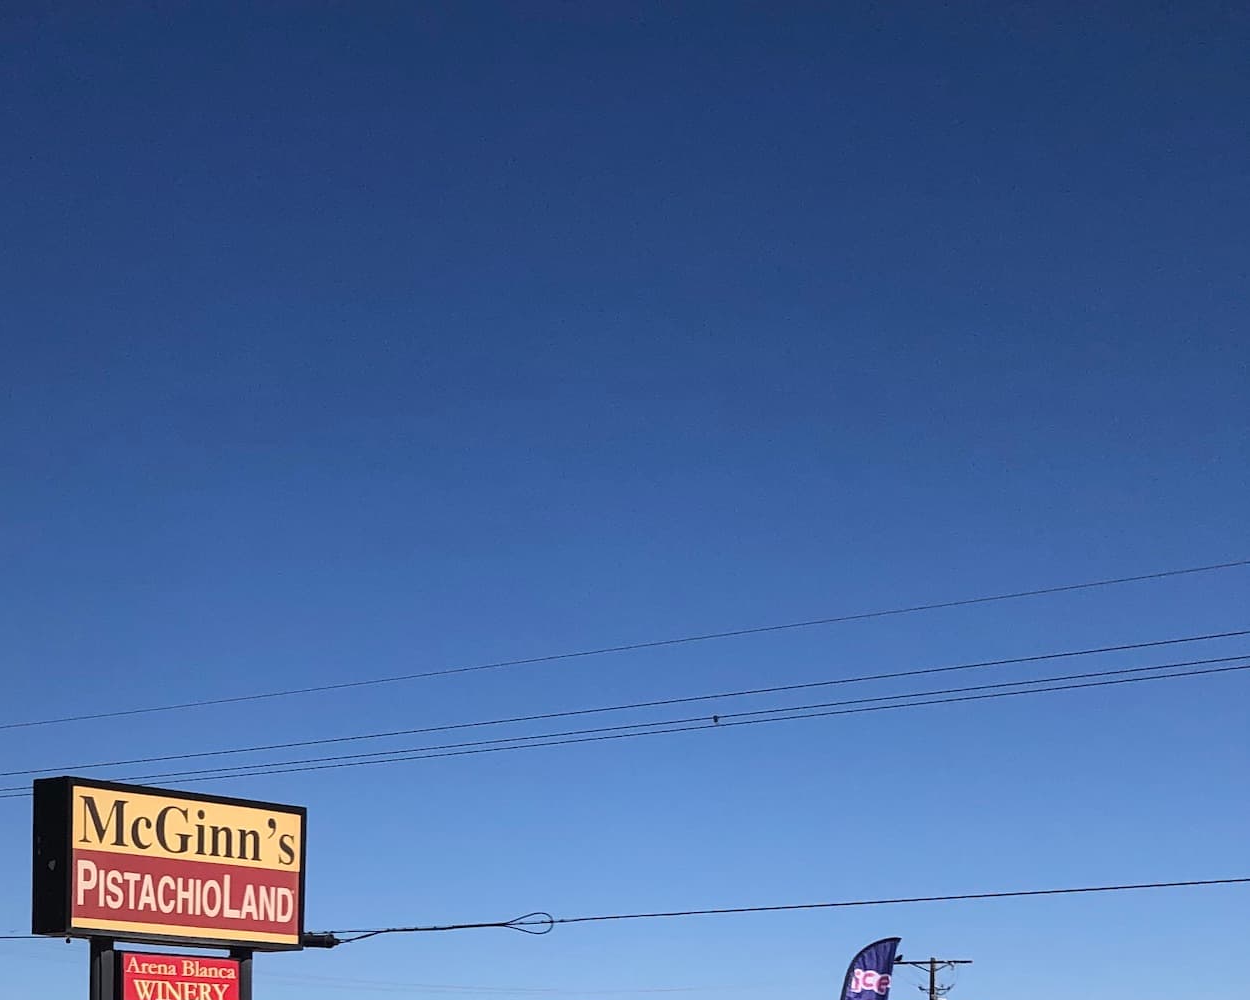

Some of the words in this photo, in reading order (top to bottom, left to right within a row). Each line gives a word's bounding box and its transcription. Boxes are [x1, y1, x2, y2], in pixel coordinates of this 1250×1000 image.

[79, 795, 296, 867] McGinn's
[126, 956, 177, 976] Arena
[181, 959, 237, 979] Blanca
